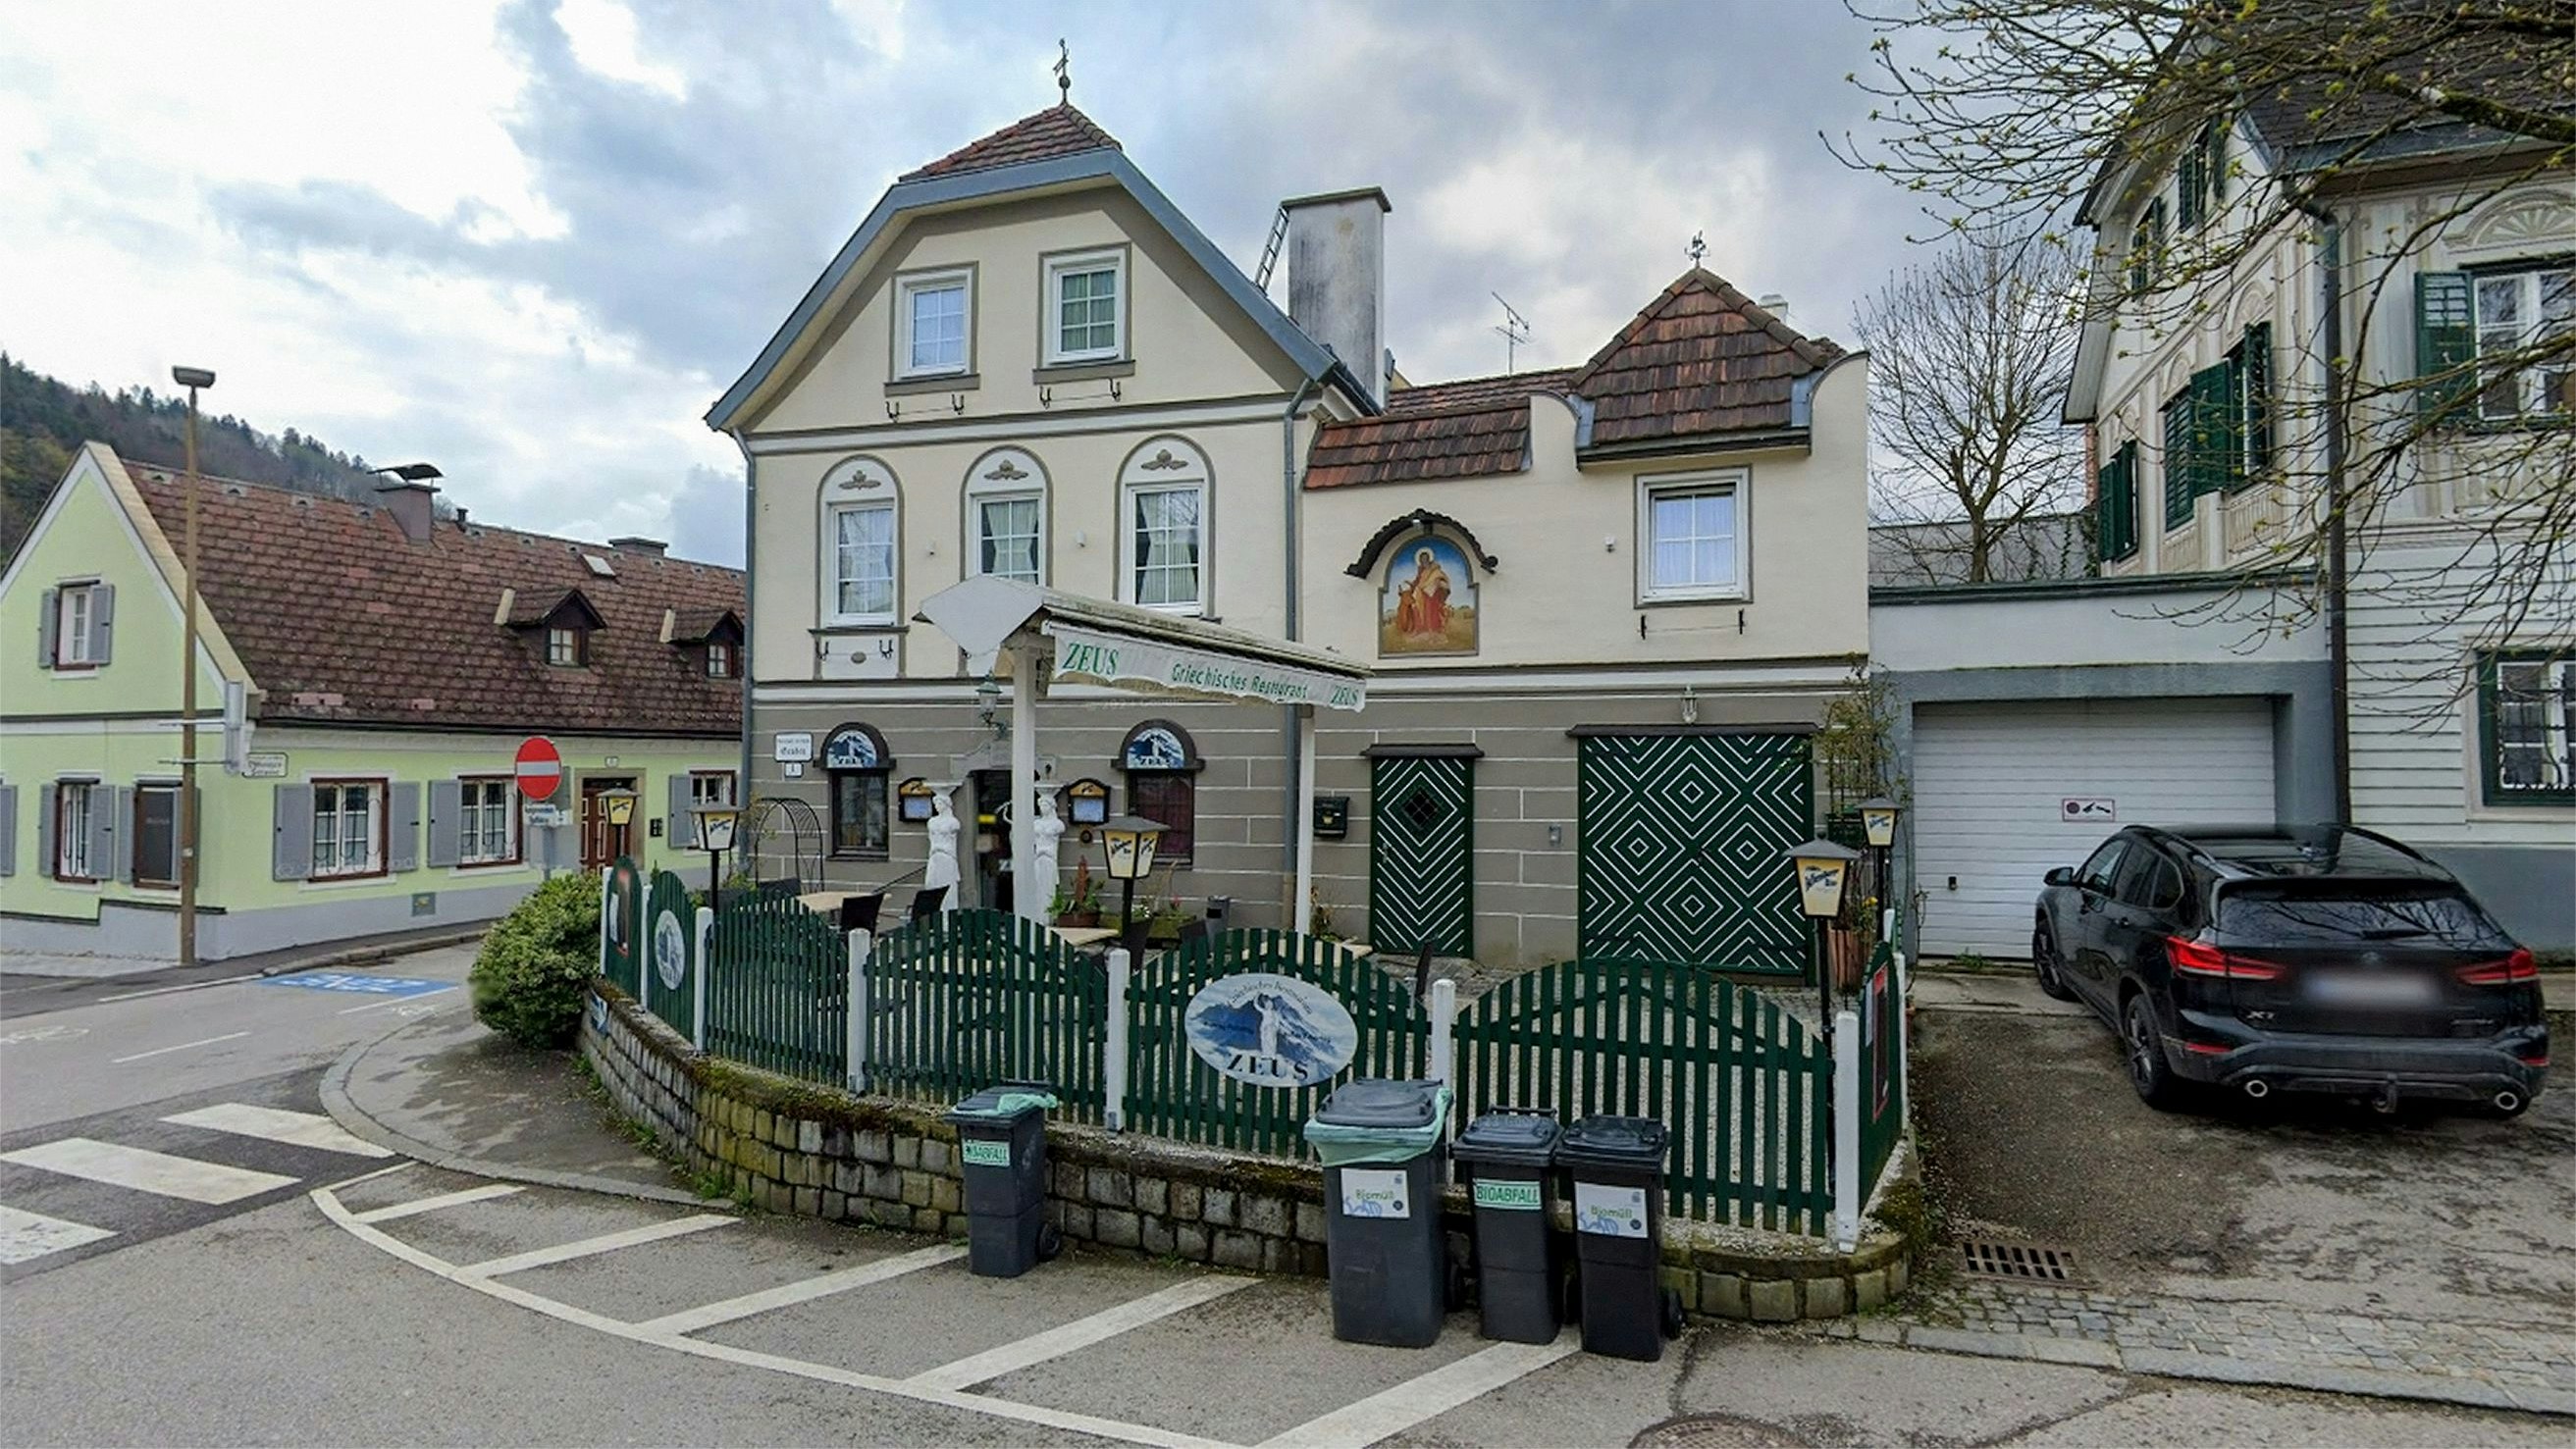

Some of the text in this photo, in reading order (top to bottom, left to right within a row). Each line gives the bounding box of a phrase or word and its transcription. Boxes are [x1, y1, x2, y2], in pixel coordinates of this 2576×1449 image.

[1062, 642, 1120, 675] ZEUS
[1172, 663, 1247, 691] Griechisches
[1330, 685, 1359, 707] ZEUS
[1227, 1054, 1309, 1080] ZEUS
[1476, 1185, 1539, 1204] BIOABFALL
